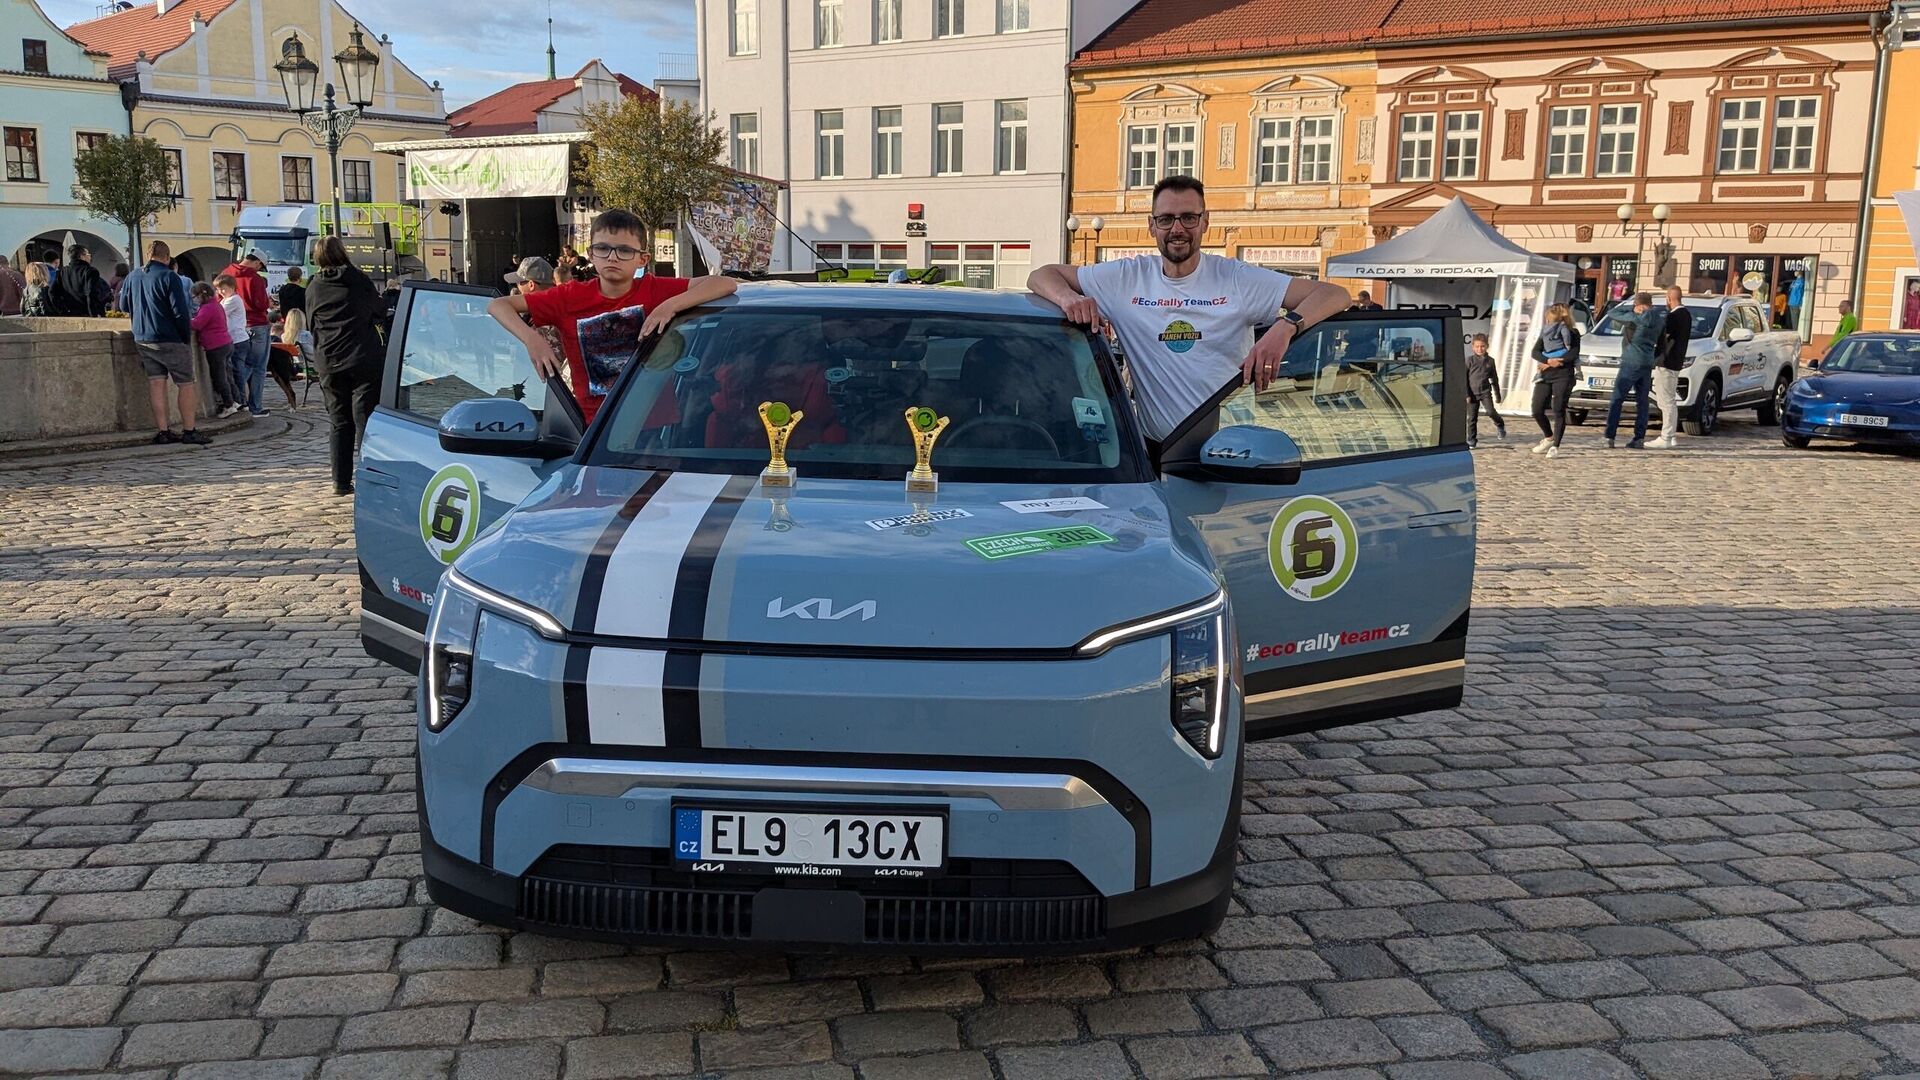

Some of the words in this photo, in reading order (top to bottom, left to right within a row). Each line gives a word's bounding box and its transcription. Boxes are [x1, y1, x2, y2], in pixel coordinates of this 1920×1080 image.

[1699, 259, 1725, 271] SPORT
[1744, 259, 1764, 271] 1976
[1784, 257, 1811, 271] VACÍK
[1356, 267, 1406, 275] RADAR
[1131, 296, 1228, 308] #EcoRallyTeamCZ
[1842, 414, 1857, 424] EL9
[475, 421, 525, 433] KIA
[1048, 529, 1100, 544] 305
[978, 536, 1024, 550] CZECH
[767, 597, 877, 622] KIA
[1246, 623, 1410, 662] #ecorallyteamcz
[711, 814, 787, 857] EL9
[823, 818, 921, 861] 13CX
[679, 840, 698, 853] CZ
[692, 863, 725, 872] KIA
[774, 864, 842, 876] www.kia.com
[874, 868, 898, 876] KIA
[899, 869, 924, 877] Charge
